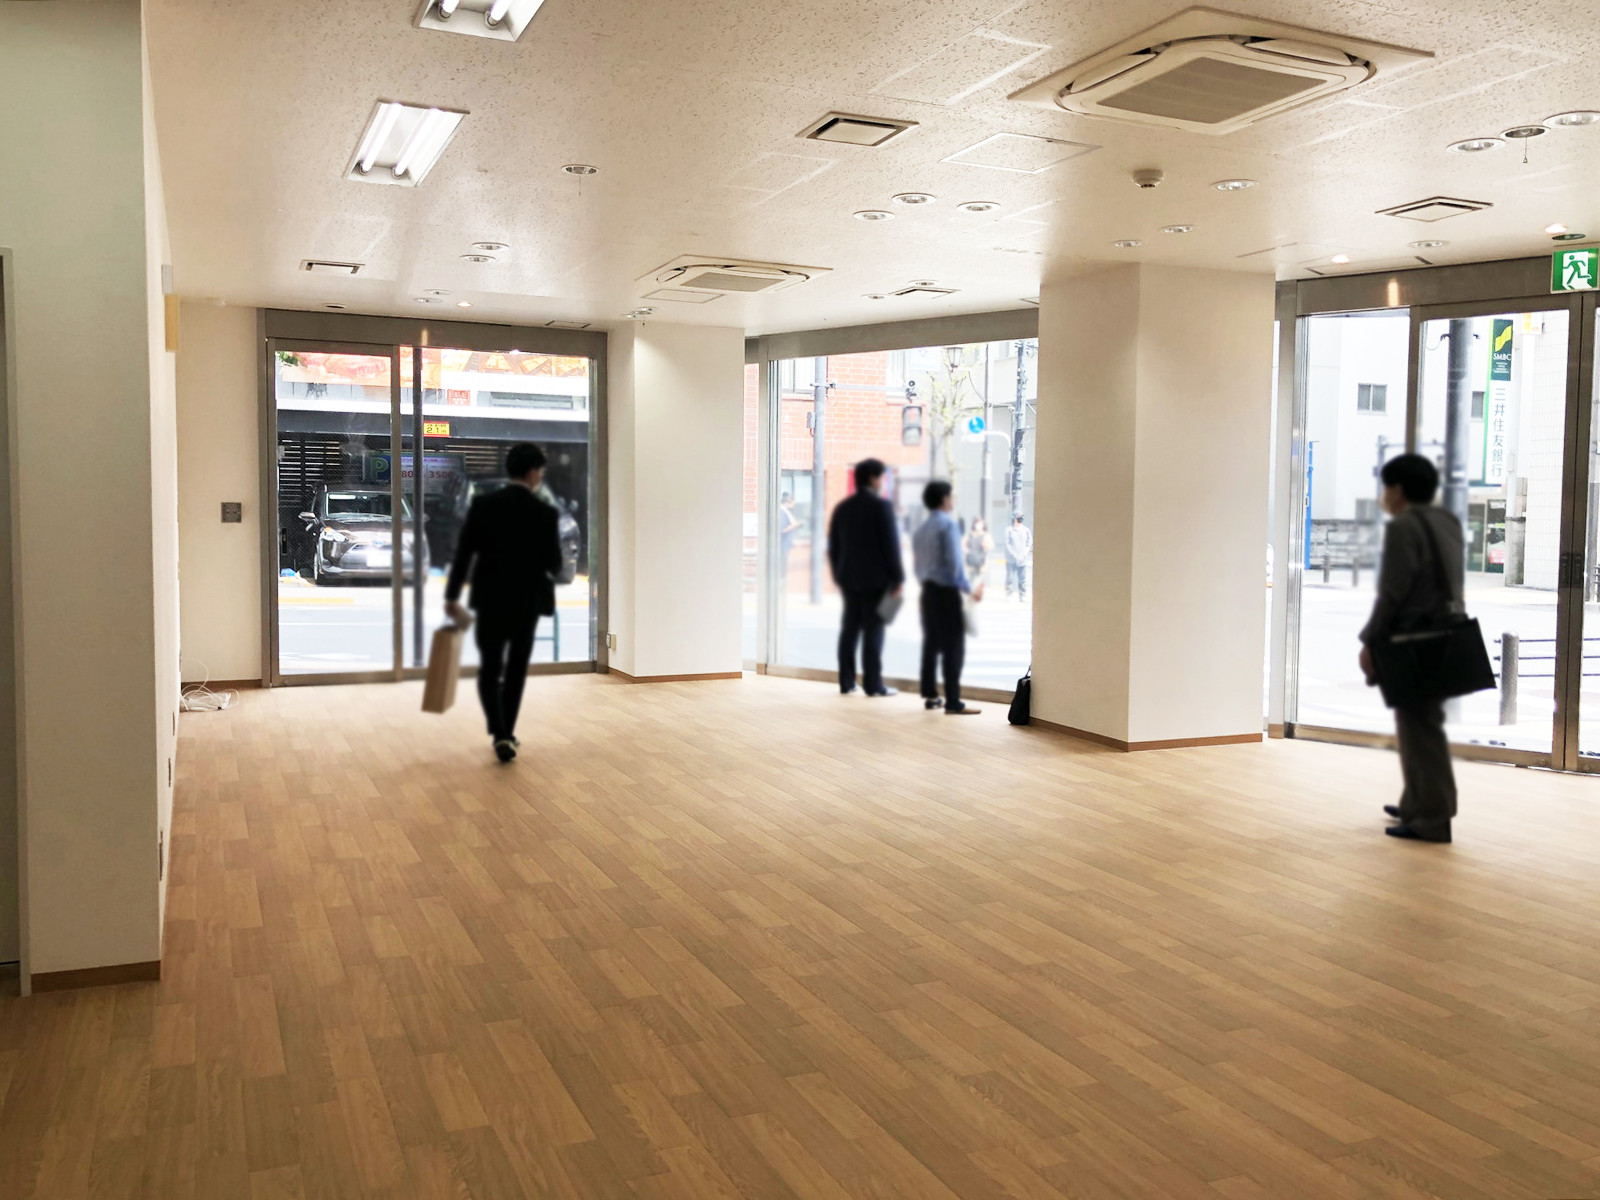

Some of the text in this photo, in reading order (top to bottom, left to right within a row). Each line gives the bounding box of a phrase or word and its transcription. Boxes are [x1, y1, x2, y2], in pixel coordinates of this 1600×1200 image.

[1493, 353, 1512, 361] SMBC
[1492, 388, 1506, 477] 三井住友銀行
[370, 458, 389, 479] P
